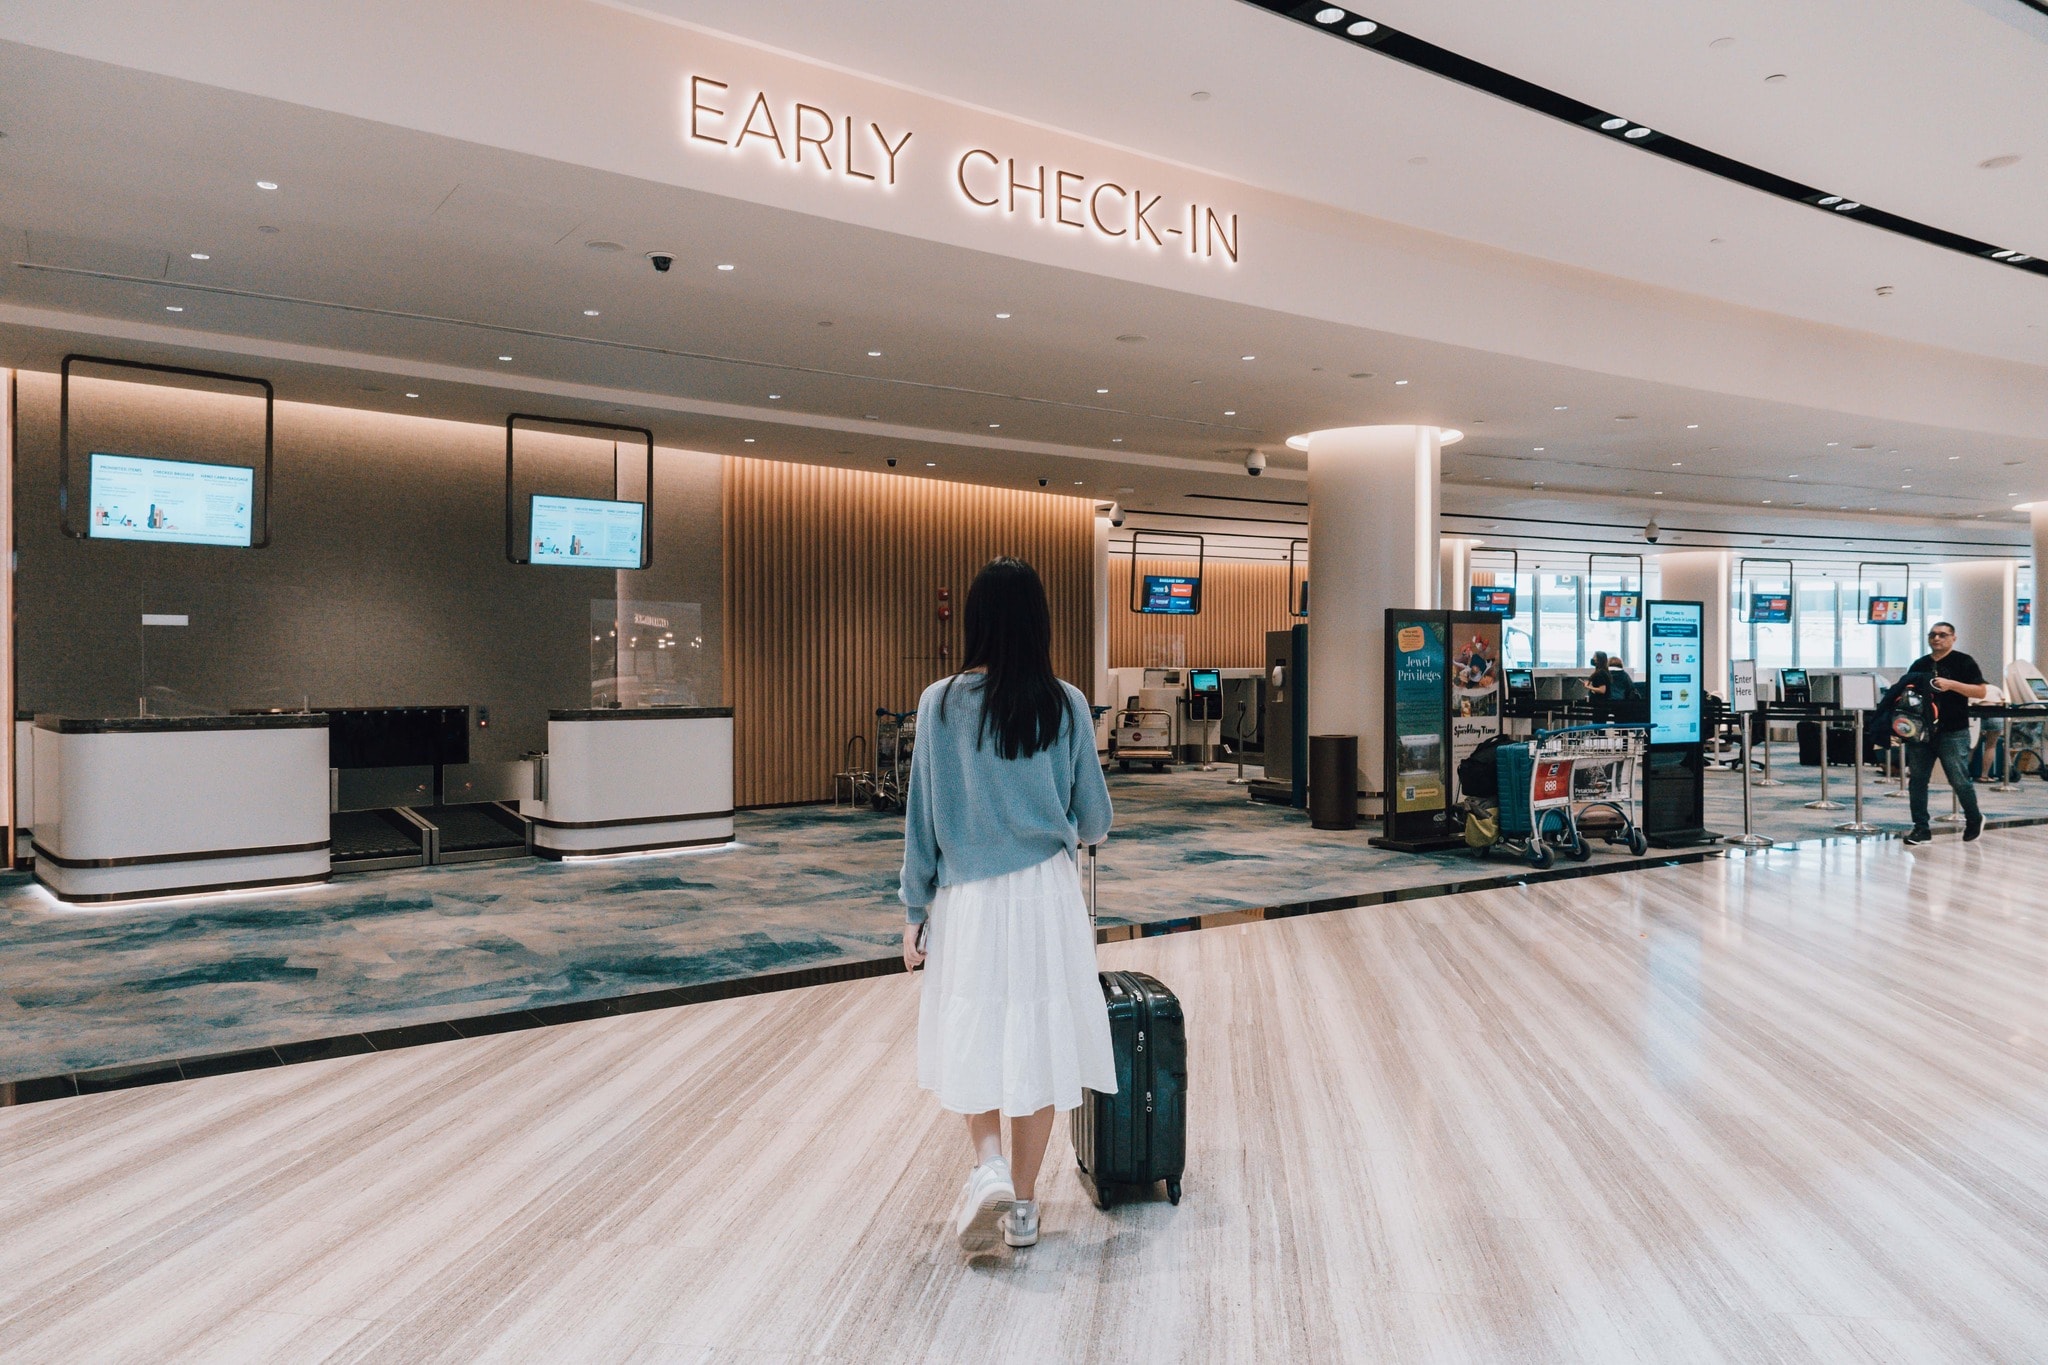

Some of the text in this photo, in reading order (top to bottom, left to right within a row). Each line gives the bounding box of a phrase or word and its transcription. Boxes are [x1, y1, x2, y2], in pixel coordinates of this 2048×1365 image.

[691, 75, 1238, 263] EARLY CHECK-IN
[1406, 656, 1430, 667] Jewel
[1398, 669, 1441, 683] Privileges
[1735, 674, 1752, 684] Enter
[1735, 687, 1752, 696] Here
[1481, 725, 1496, 734] Time
[1544, 780, 1557, 792] 888
